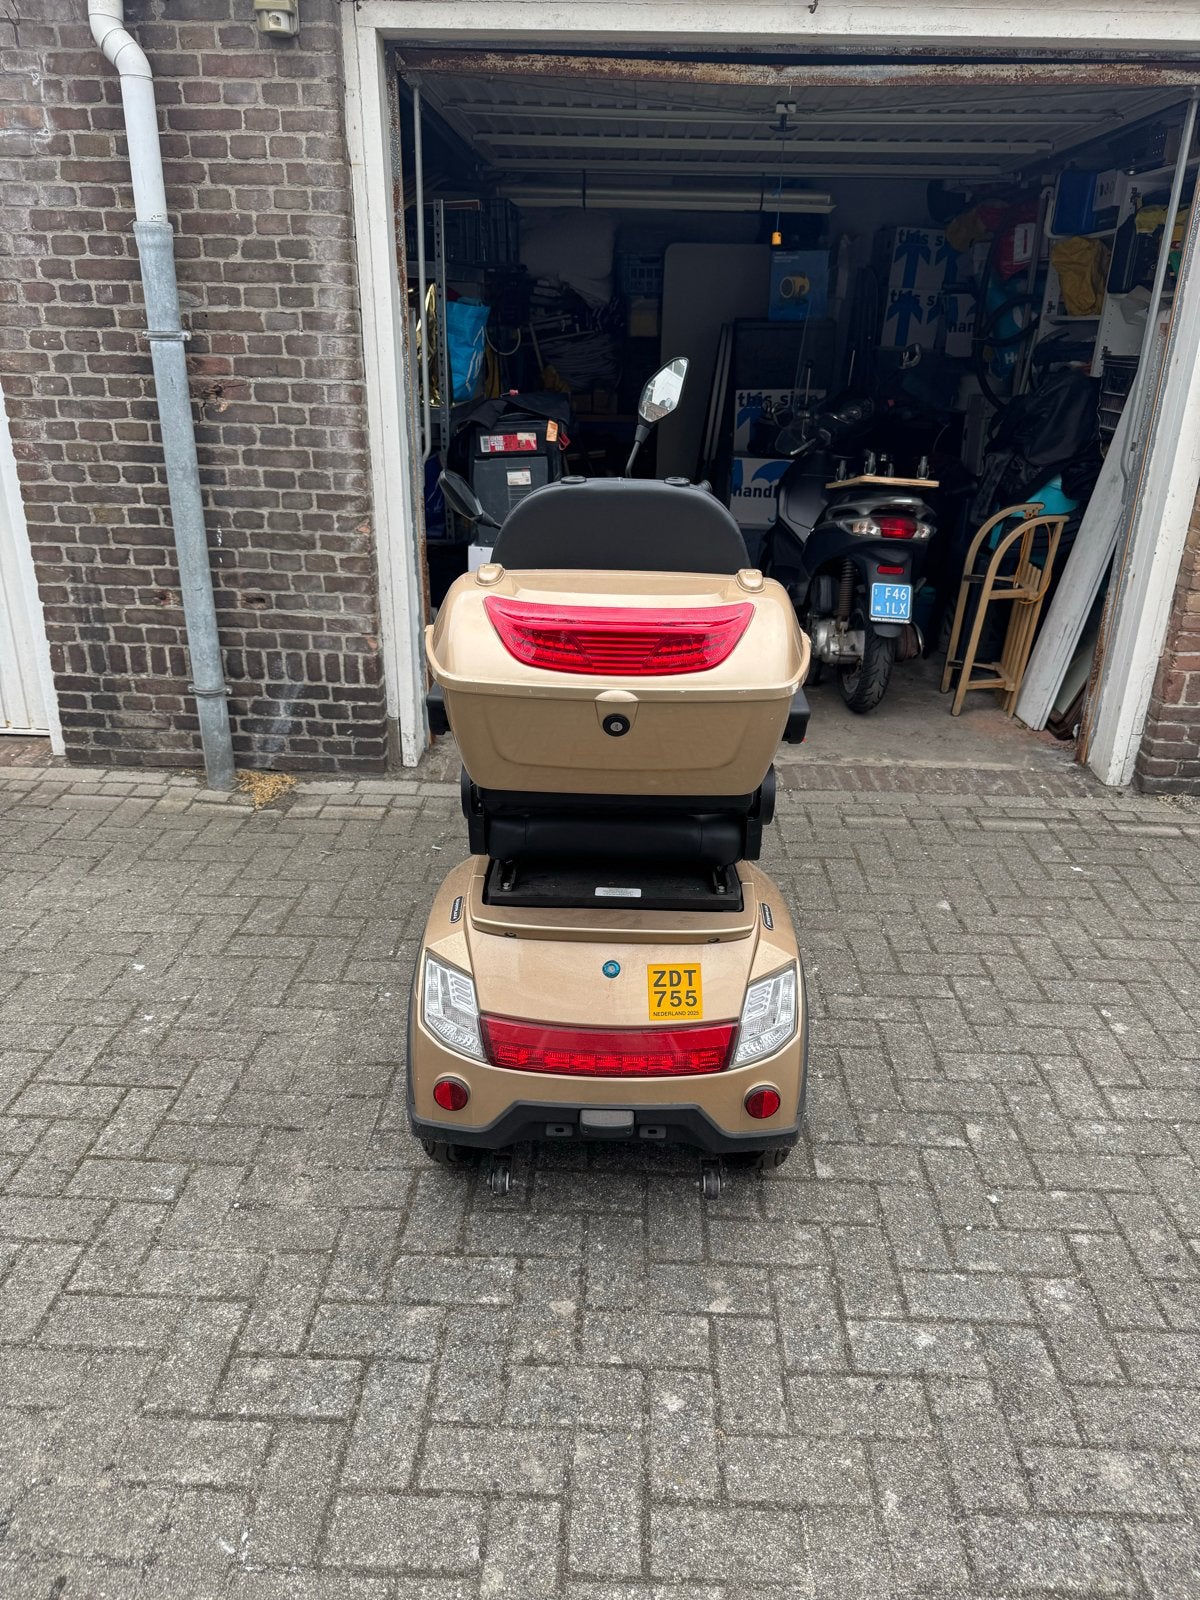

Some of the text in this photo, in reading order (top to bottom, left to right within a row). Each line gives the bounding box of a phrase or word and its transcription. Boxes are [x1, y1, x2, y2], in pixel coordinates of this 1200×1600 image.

[885, 587, 907, 600] F46
[886, 602, 906, 615] 1LX
[653, 970, 697, 987] ZDT
[653, 990, 698, 1007] 755
